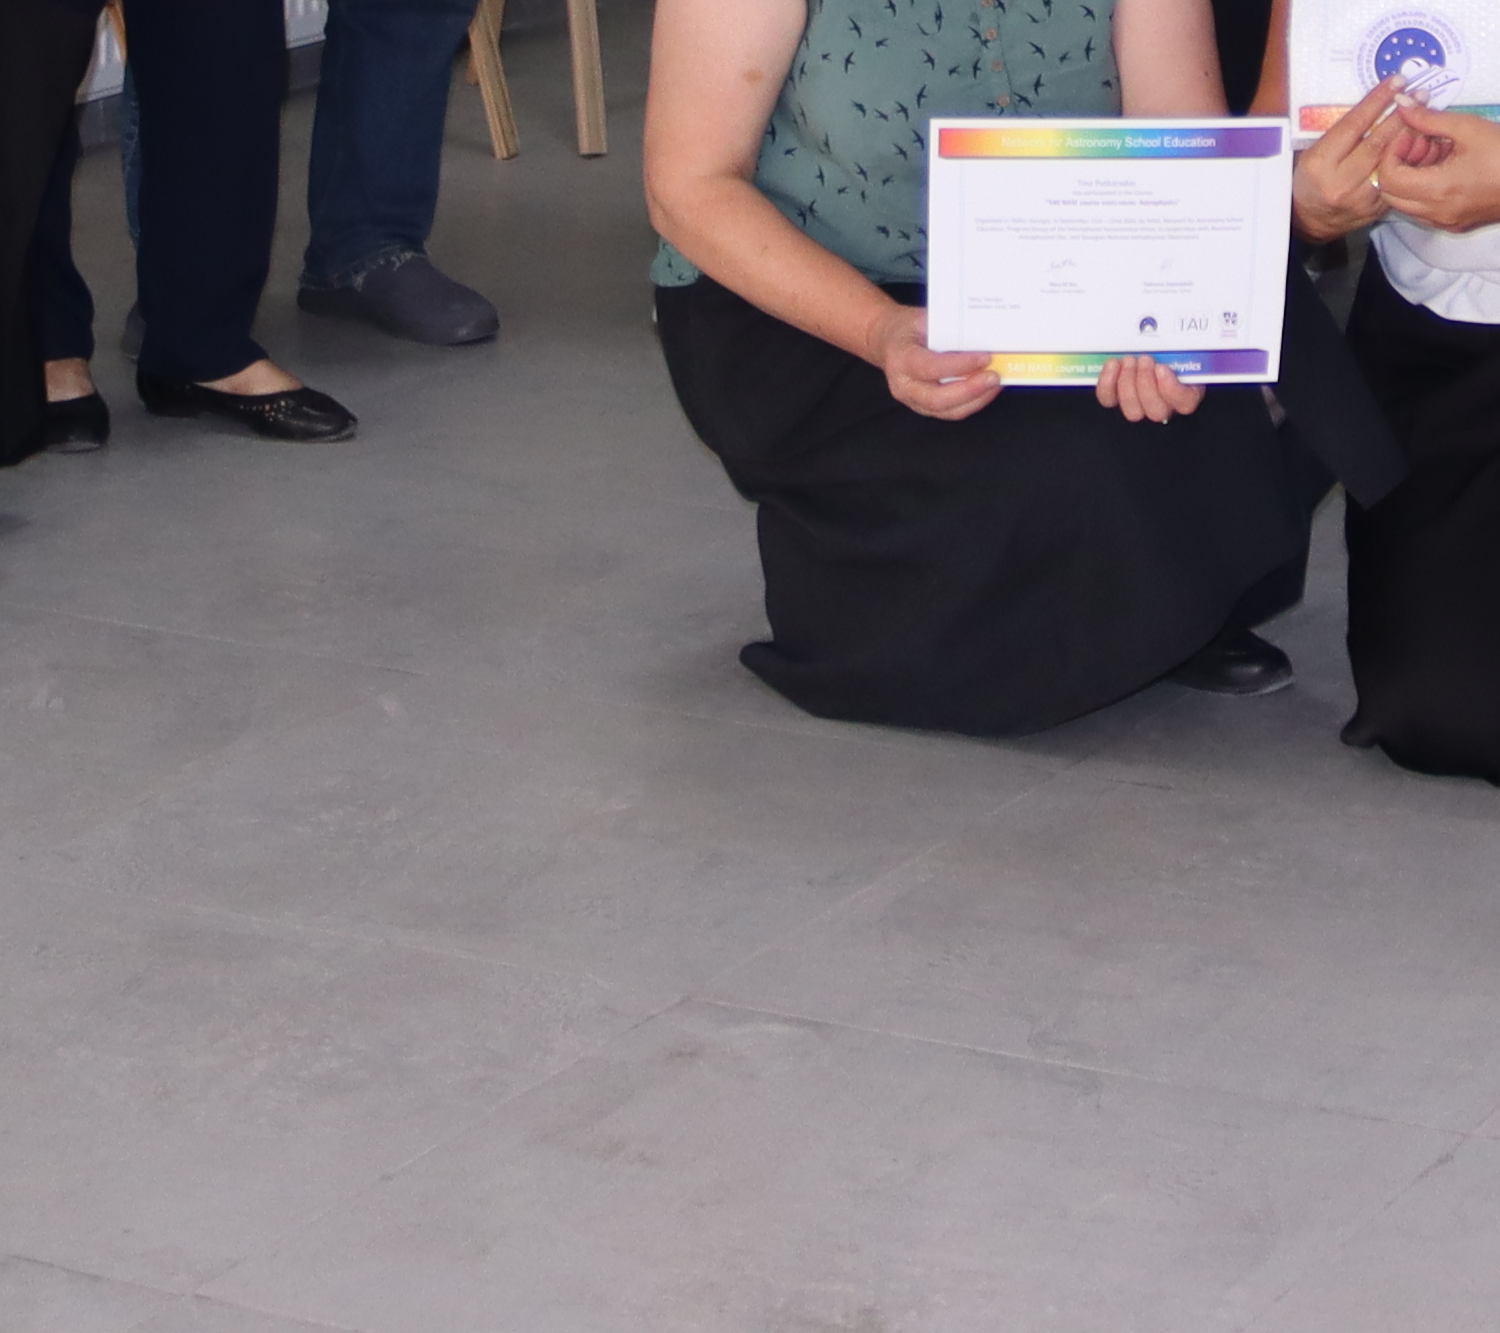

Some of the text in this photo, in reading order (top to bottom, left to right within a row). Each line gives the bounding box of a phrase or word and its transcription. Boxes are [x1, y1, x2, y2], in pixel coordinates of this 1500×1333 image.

[1065, 136, 1122, 151] Astronomy
[1125, 135, 1161, 149] School
[1164, 135, 1216, 149] Education
[1181, 318, 1209, 332] IAU
[1056, 364, 1086, 374] course
